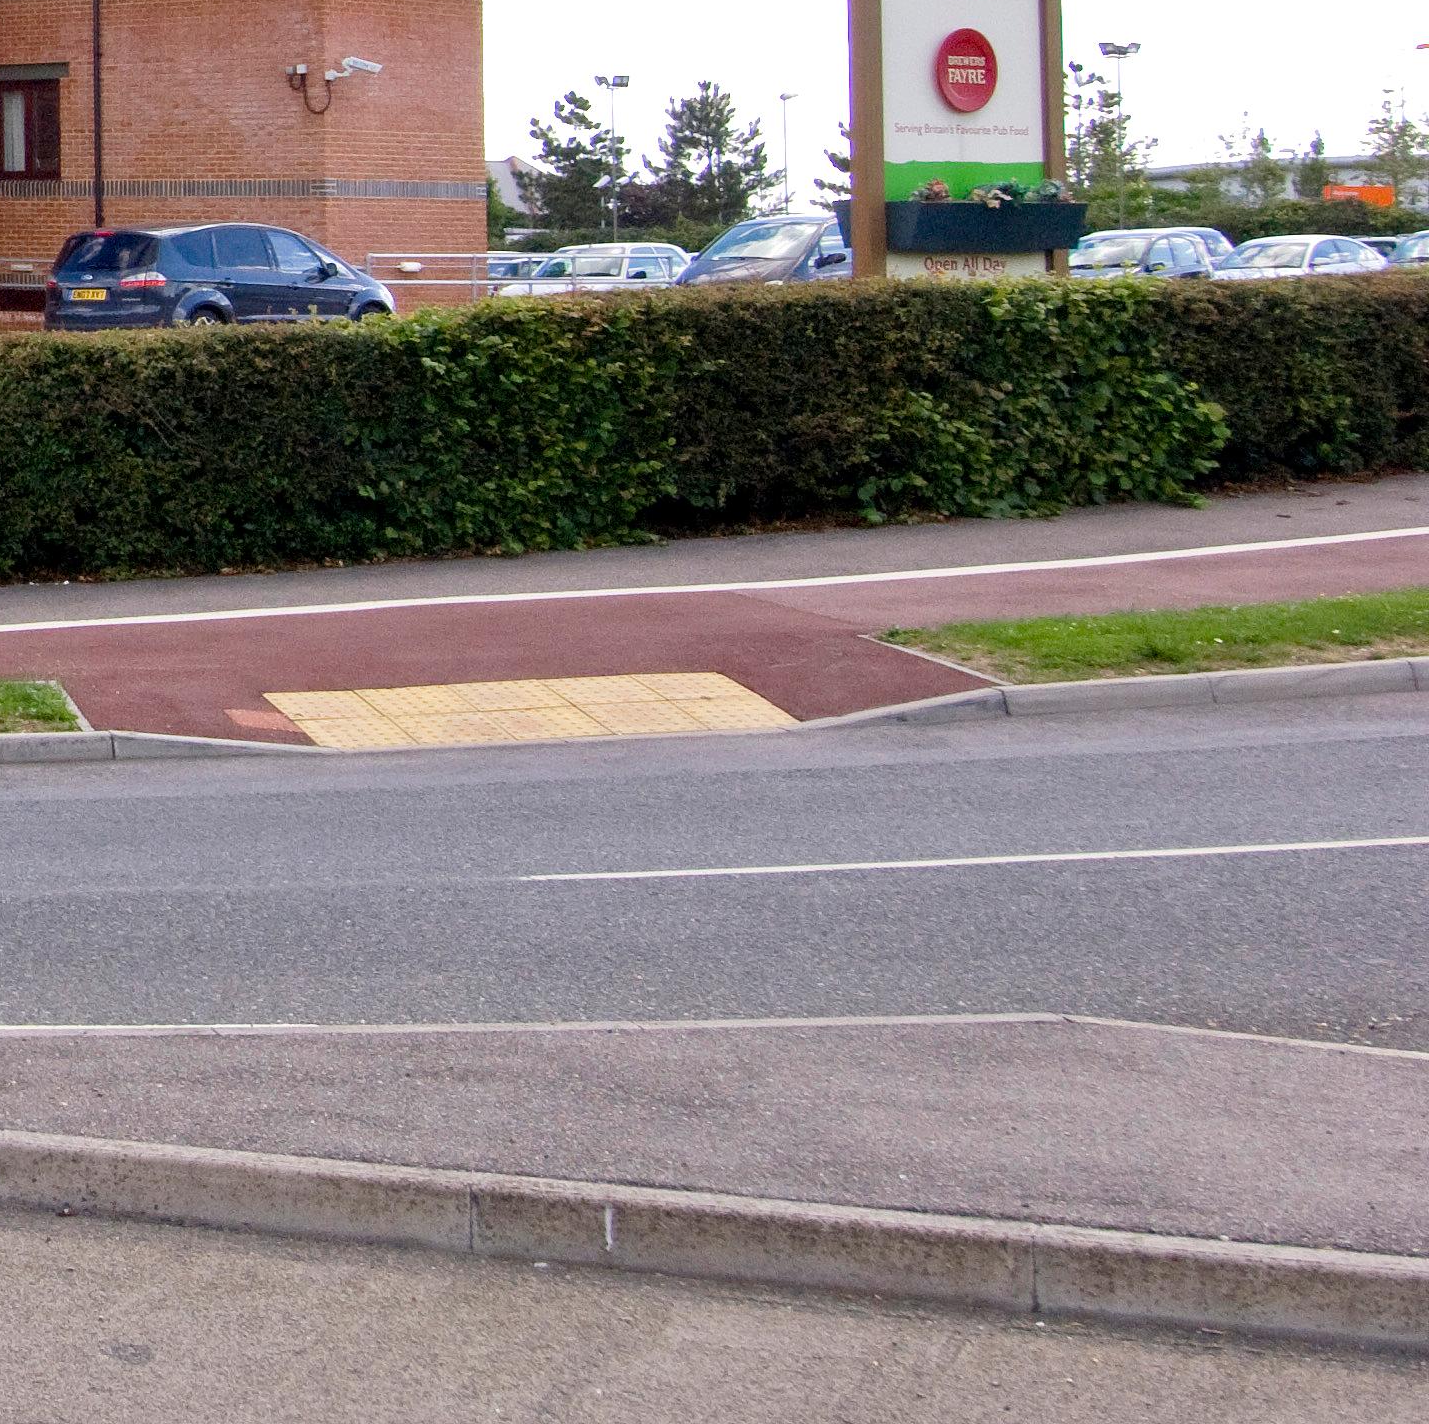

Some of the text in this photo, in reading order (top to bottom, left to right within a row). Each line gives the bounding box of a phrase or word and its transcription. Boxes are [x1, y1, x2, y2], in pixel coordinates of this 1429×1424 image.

[948, 68, 986, 84] FAYRE
[894, 122, 922, 136] Serving
[924, 124, 955, 135] Britain's
[993, 126, 1008, 136] Pub
[1009, 126, 1029, 136] Food
[923, 256, 1006, 274] Open All Day
